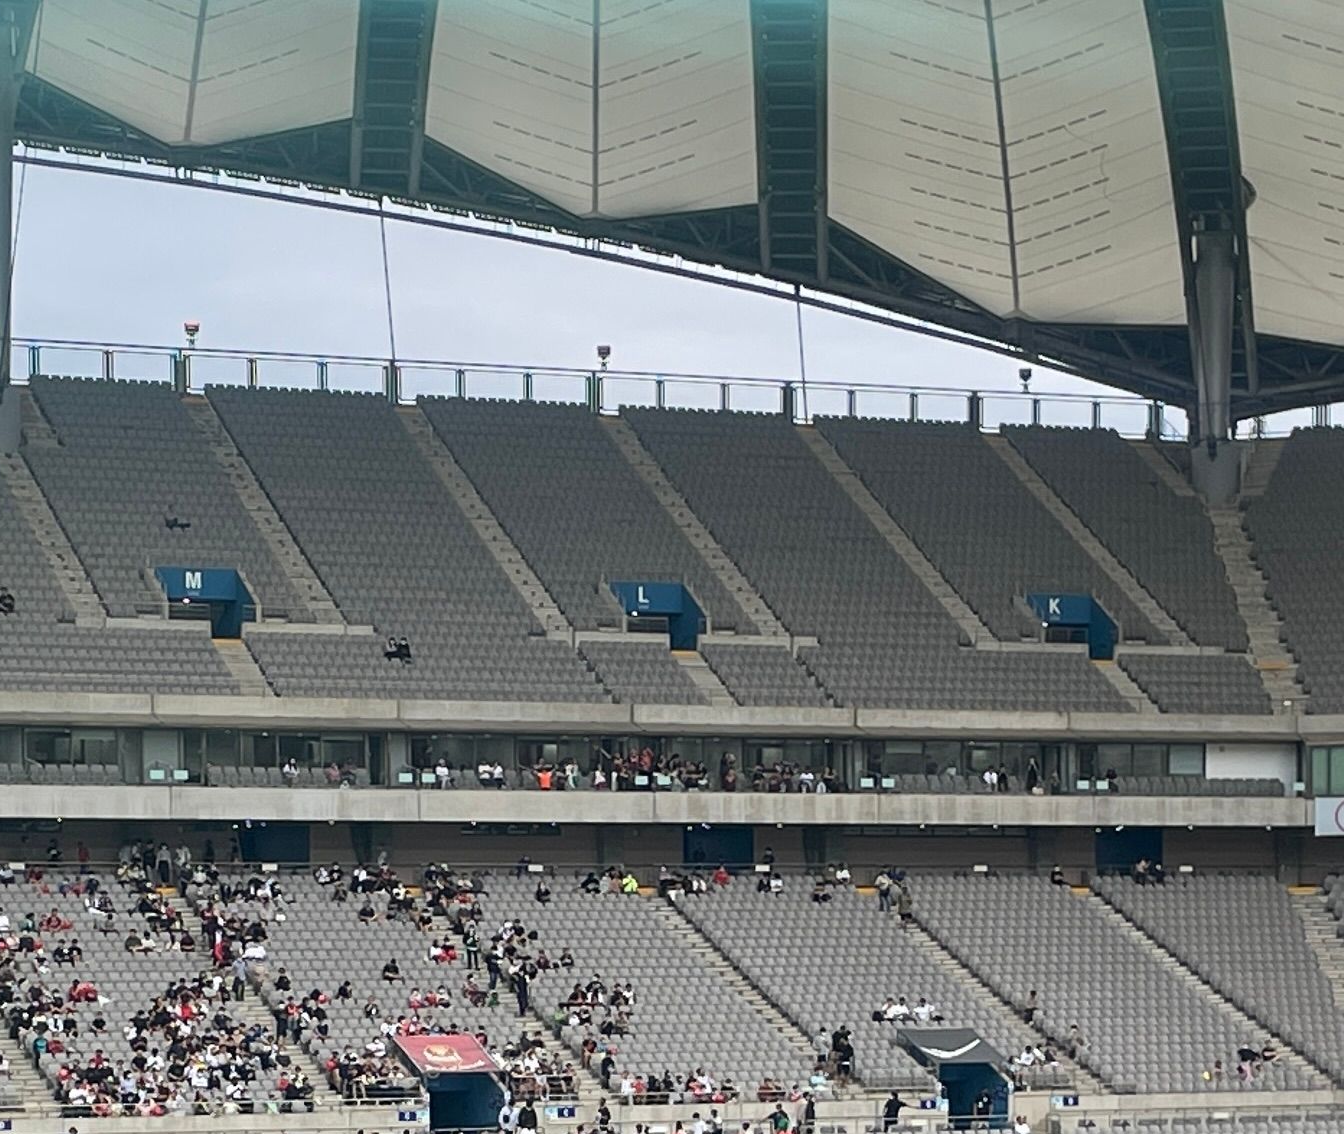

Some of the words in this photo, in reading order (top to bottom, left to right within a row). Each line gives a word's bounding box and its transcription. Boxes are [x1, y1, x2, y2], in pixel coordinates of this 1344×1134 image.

[185, 571, 202, 589] M
[638, 586, 649, 603] L
[1049, 598, 1060, 614] K
